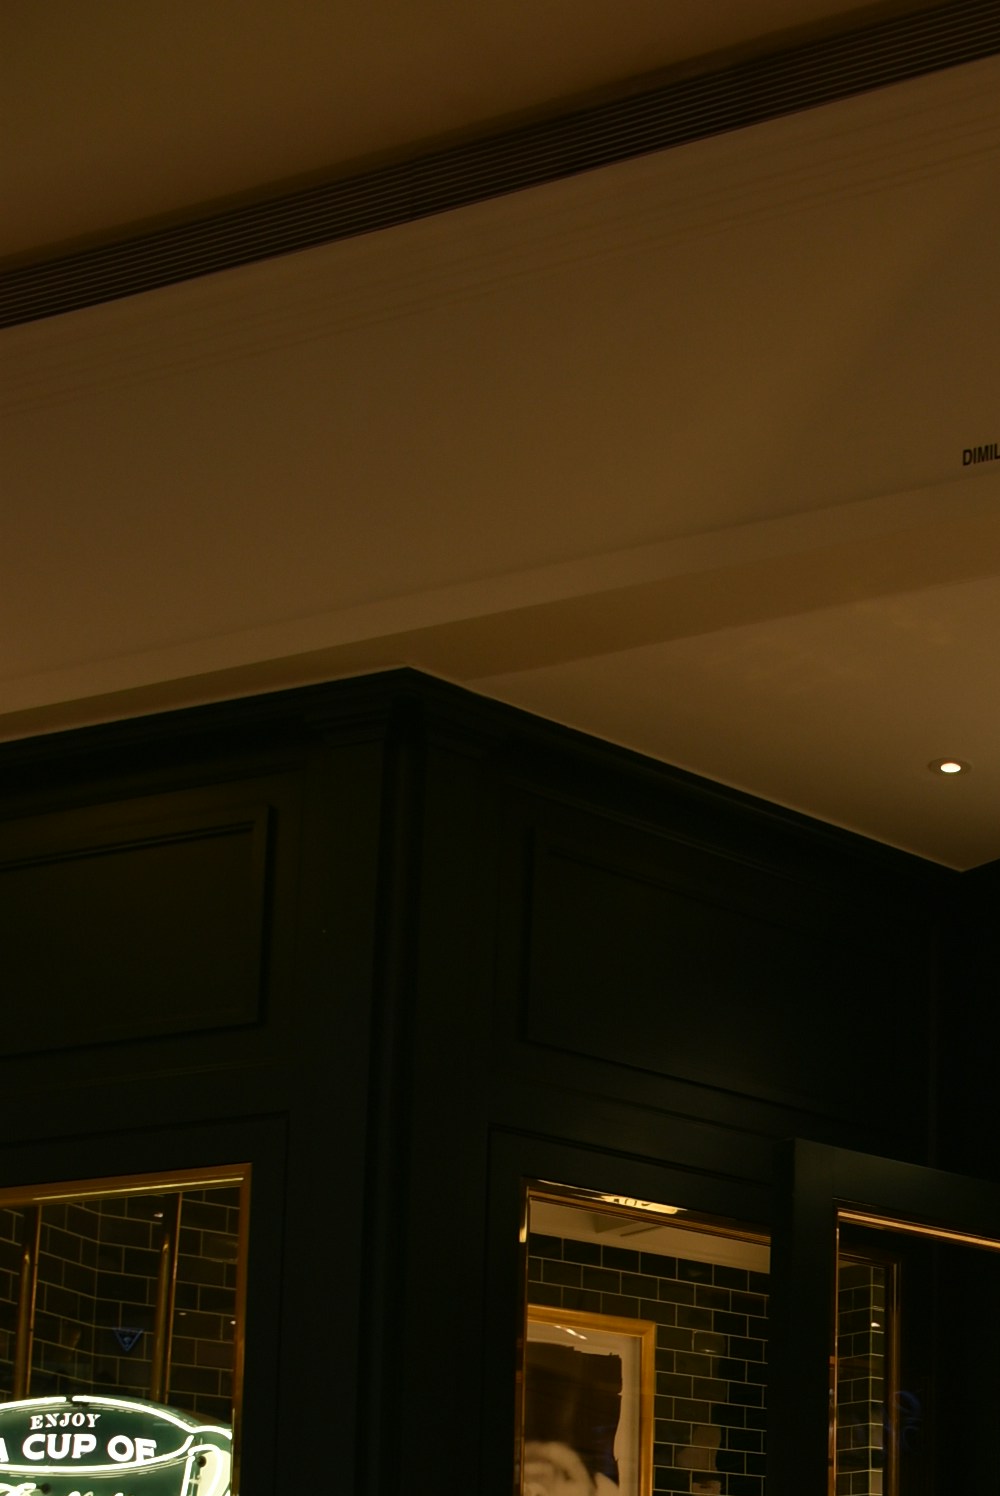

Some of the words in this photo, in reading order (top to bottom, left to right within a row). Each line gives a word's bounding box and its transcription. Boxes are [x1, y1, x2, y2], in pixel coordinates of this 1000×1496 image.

[30, 1413, 101, 1430] ENJOY
[22, 1433, 97, 1461] CUP
[107, 1435, 157, 1465] OF
